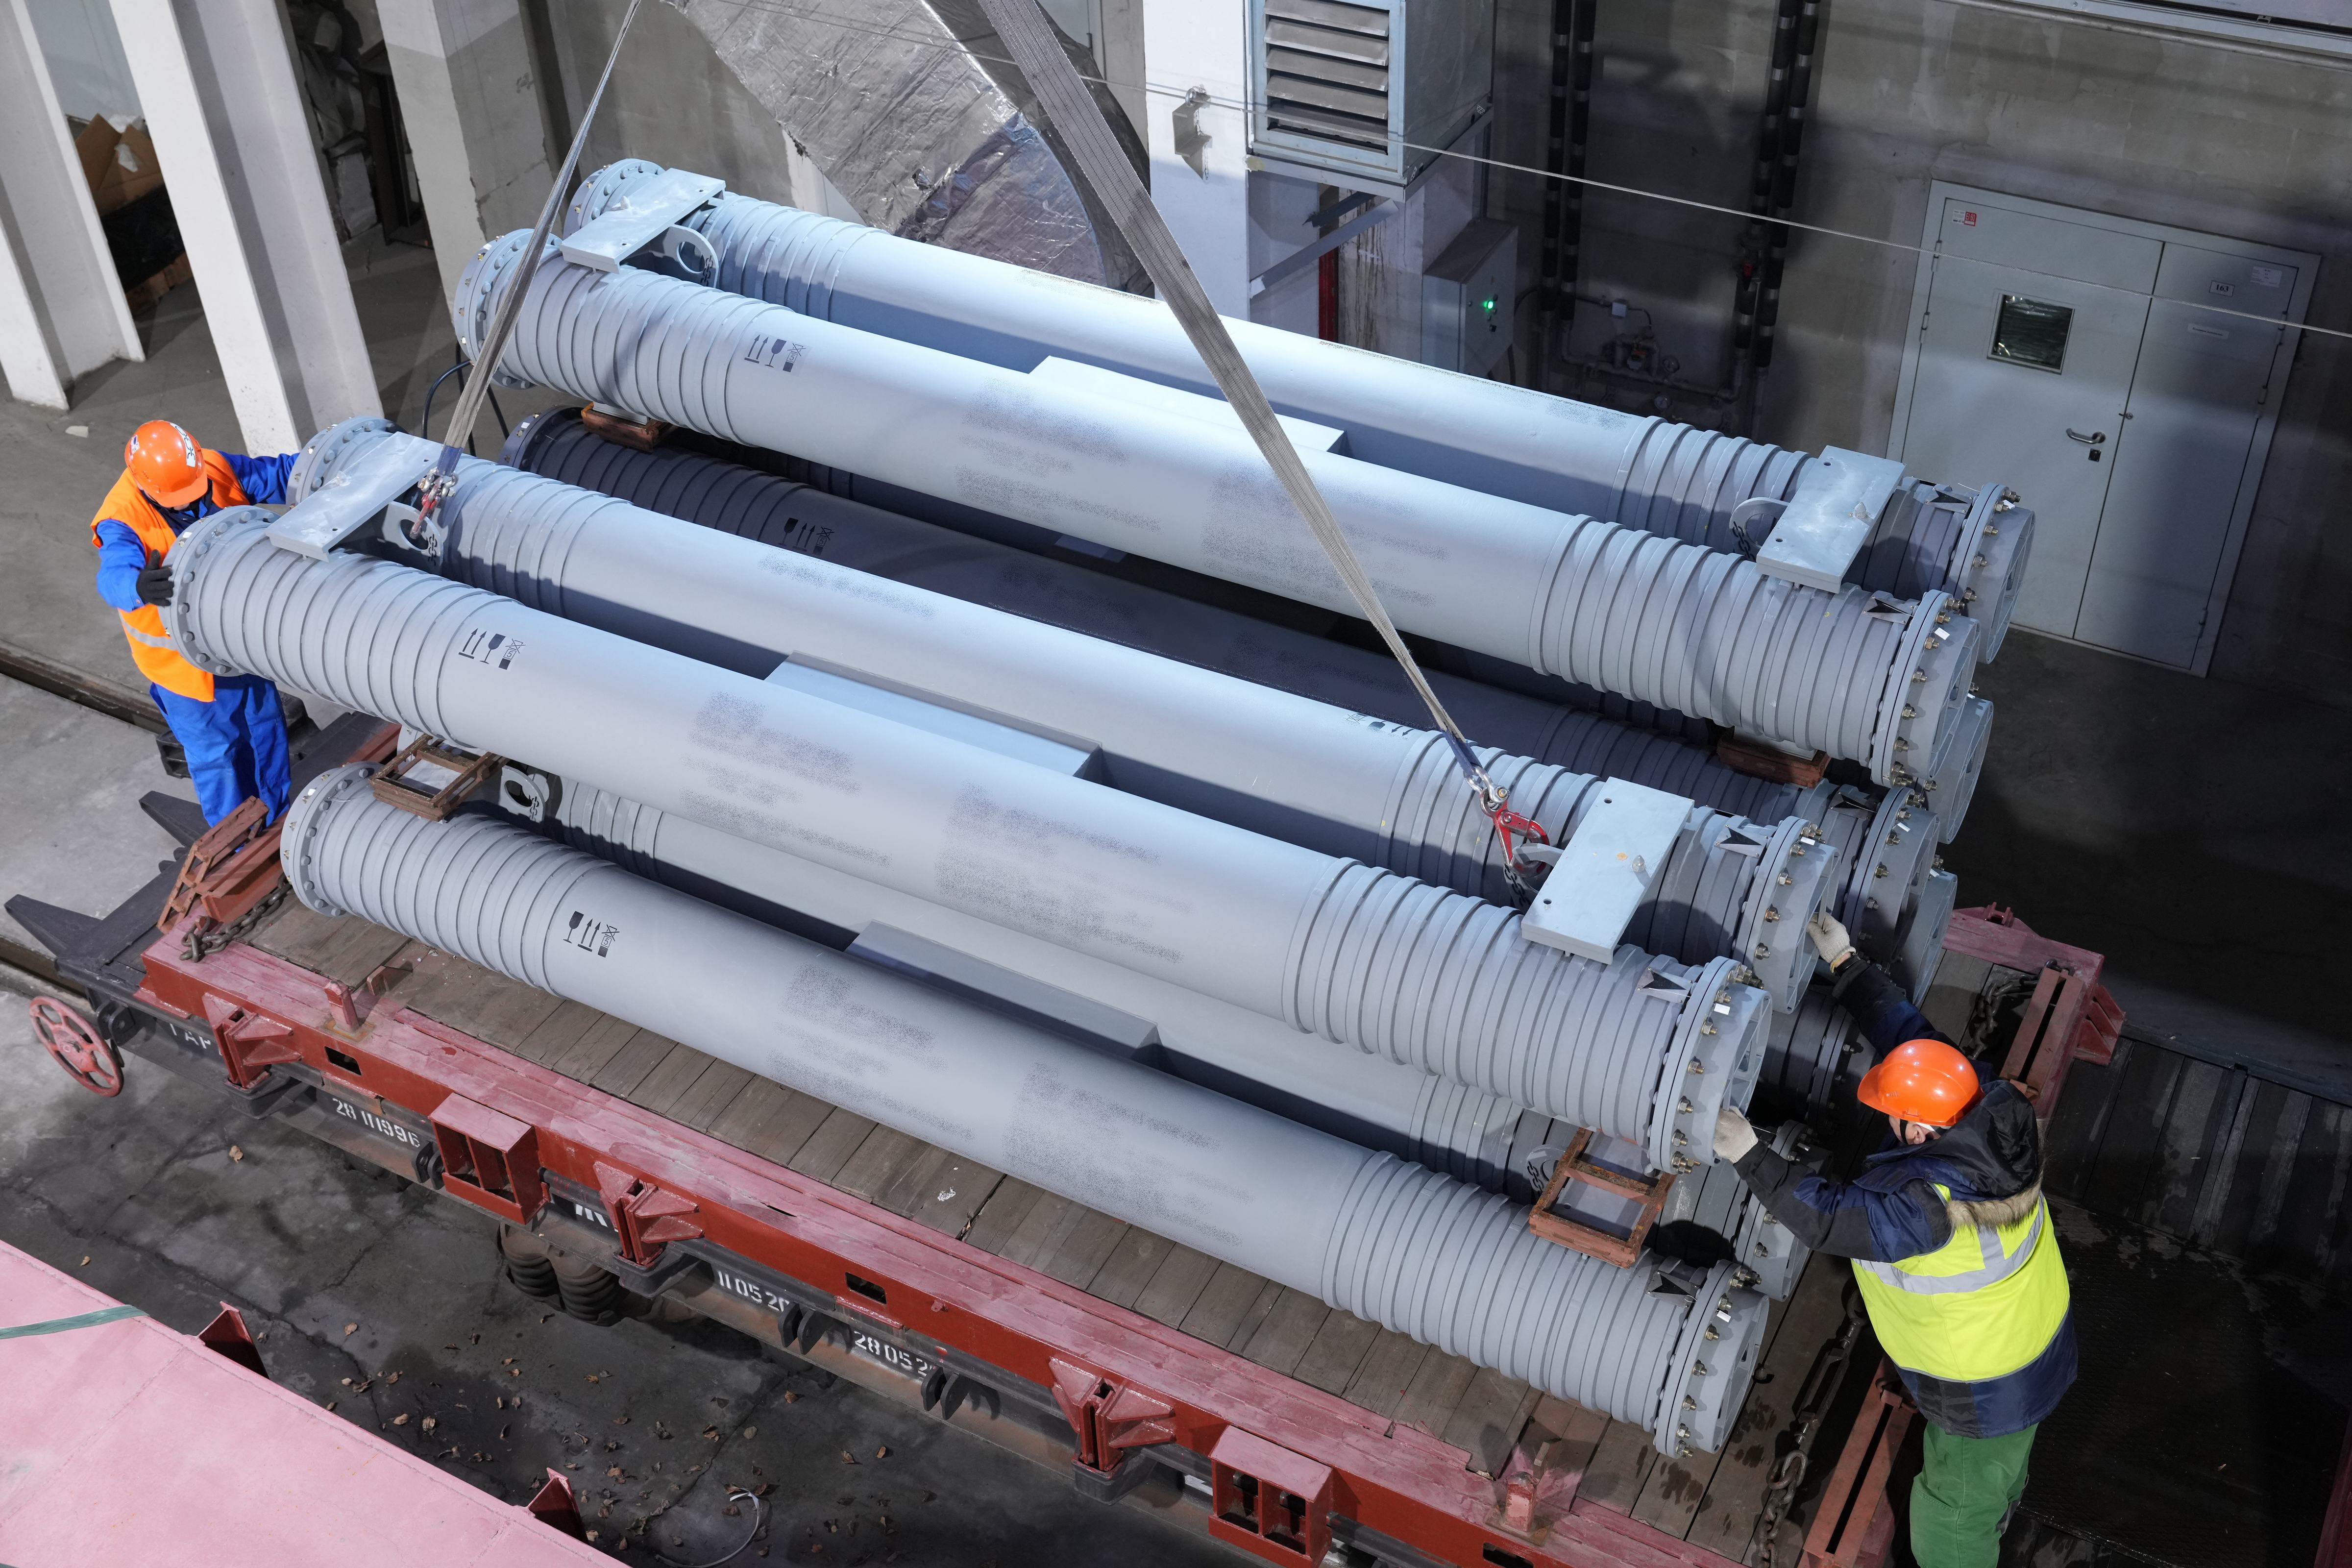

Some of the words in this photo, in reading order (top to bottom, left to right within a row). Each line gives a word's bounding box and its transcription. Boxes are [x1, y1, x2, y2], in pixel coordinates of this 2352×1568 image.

[332, 1098, 357, 1121] 28
[717, 1270, 732, 1289] 11
[735, 1277, 762, 1304] 05
[854, 1330, 880, 1355] 28
[884, 1345, 913, 1370] 05
